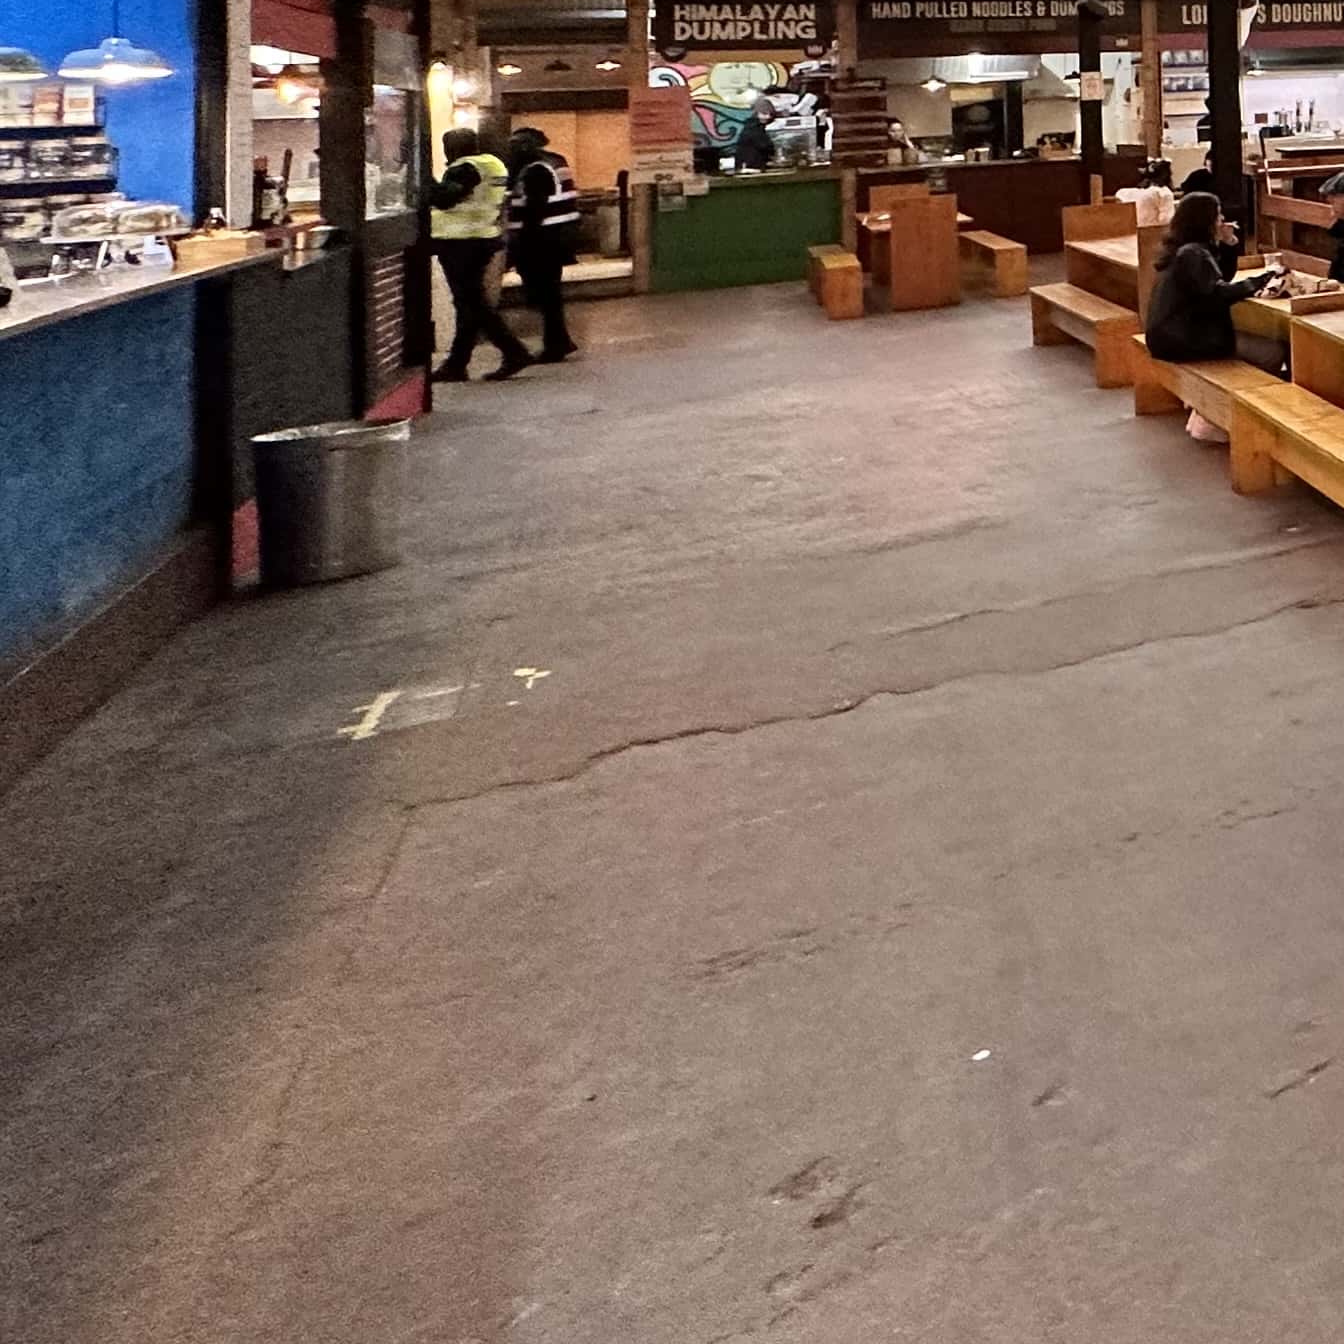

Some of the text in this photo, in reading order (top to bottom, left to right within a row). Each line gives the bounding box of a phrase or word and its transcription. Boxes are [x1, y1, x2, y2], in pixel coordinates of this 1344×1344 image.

[674, 3, 816, 21] HIMALAYAN
[871, 1, 912, 19] HAND
[915, 1, 968, 18] PULLED
[972, 0, 1033, 17] NOODLES
[1050, 0, 1125, 17] DUMGS
[674, 20, 817, 40] DUMPLING
